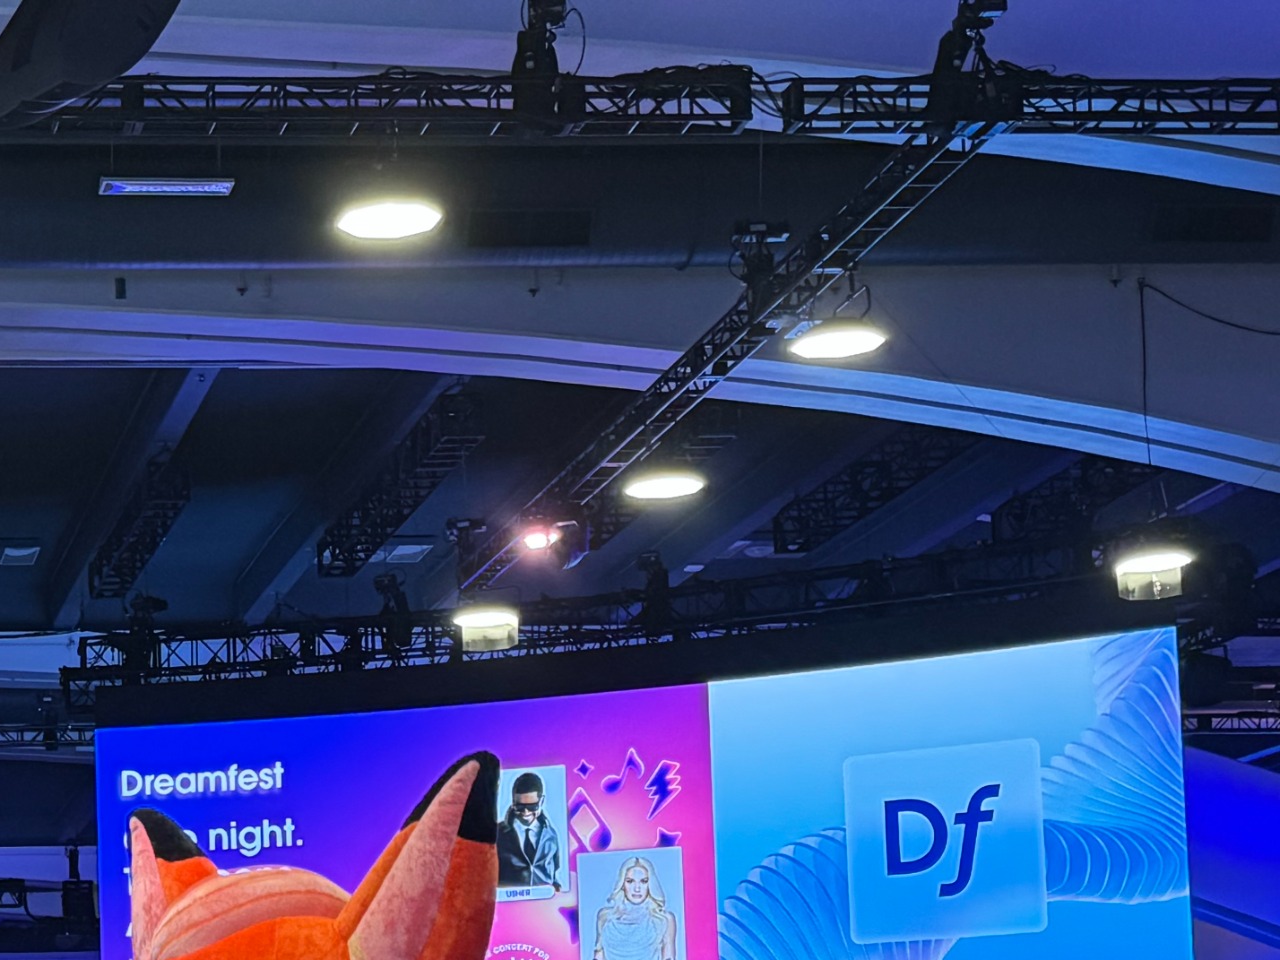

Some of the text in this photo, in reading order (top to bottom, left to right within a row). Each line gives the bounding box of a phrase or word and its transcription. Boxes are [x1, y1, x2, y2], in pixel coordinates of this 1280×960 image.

[120, 761, 285, 797] Dreamfest
[208, 818, 304, 857] night.
[884, 783, 1001, 898] Df
[492, 943, 534, 954] CONCERT
